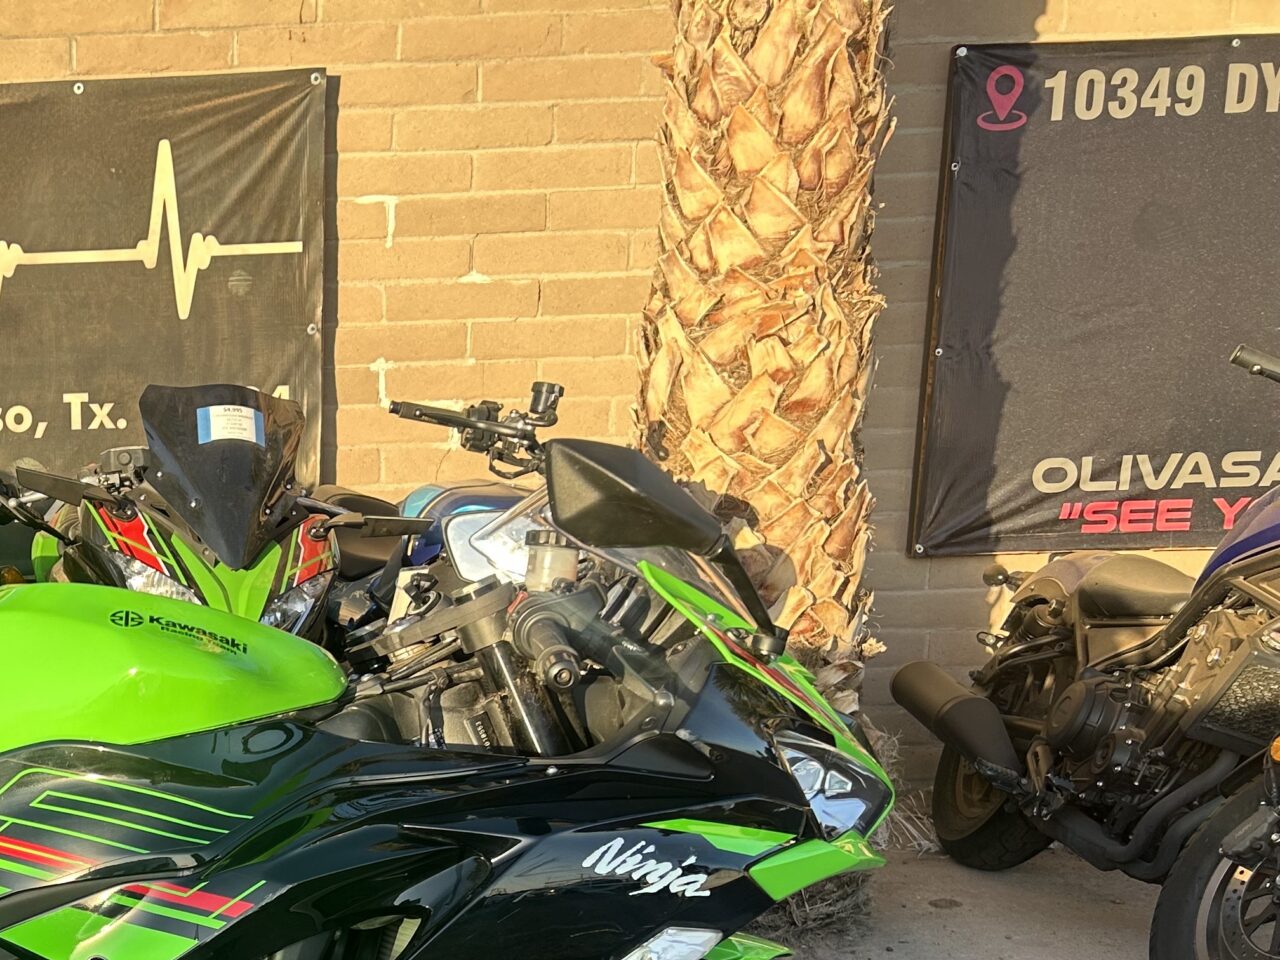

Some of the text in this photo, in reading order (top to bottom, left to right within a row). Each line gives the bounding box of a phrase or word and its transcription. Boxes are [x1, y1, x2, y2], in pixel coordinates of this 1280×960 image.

[1044, 62, 1280, 122] 10349 DY
[62, 392, 128, 432] Tx.
[1059, 499, 1194, 534] "SEE
[149, 615, 248, 655] Kawasaki
[582, 837, 711, 897] Ninja
